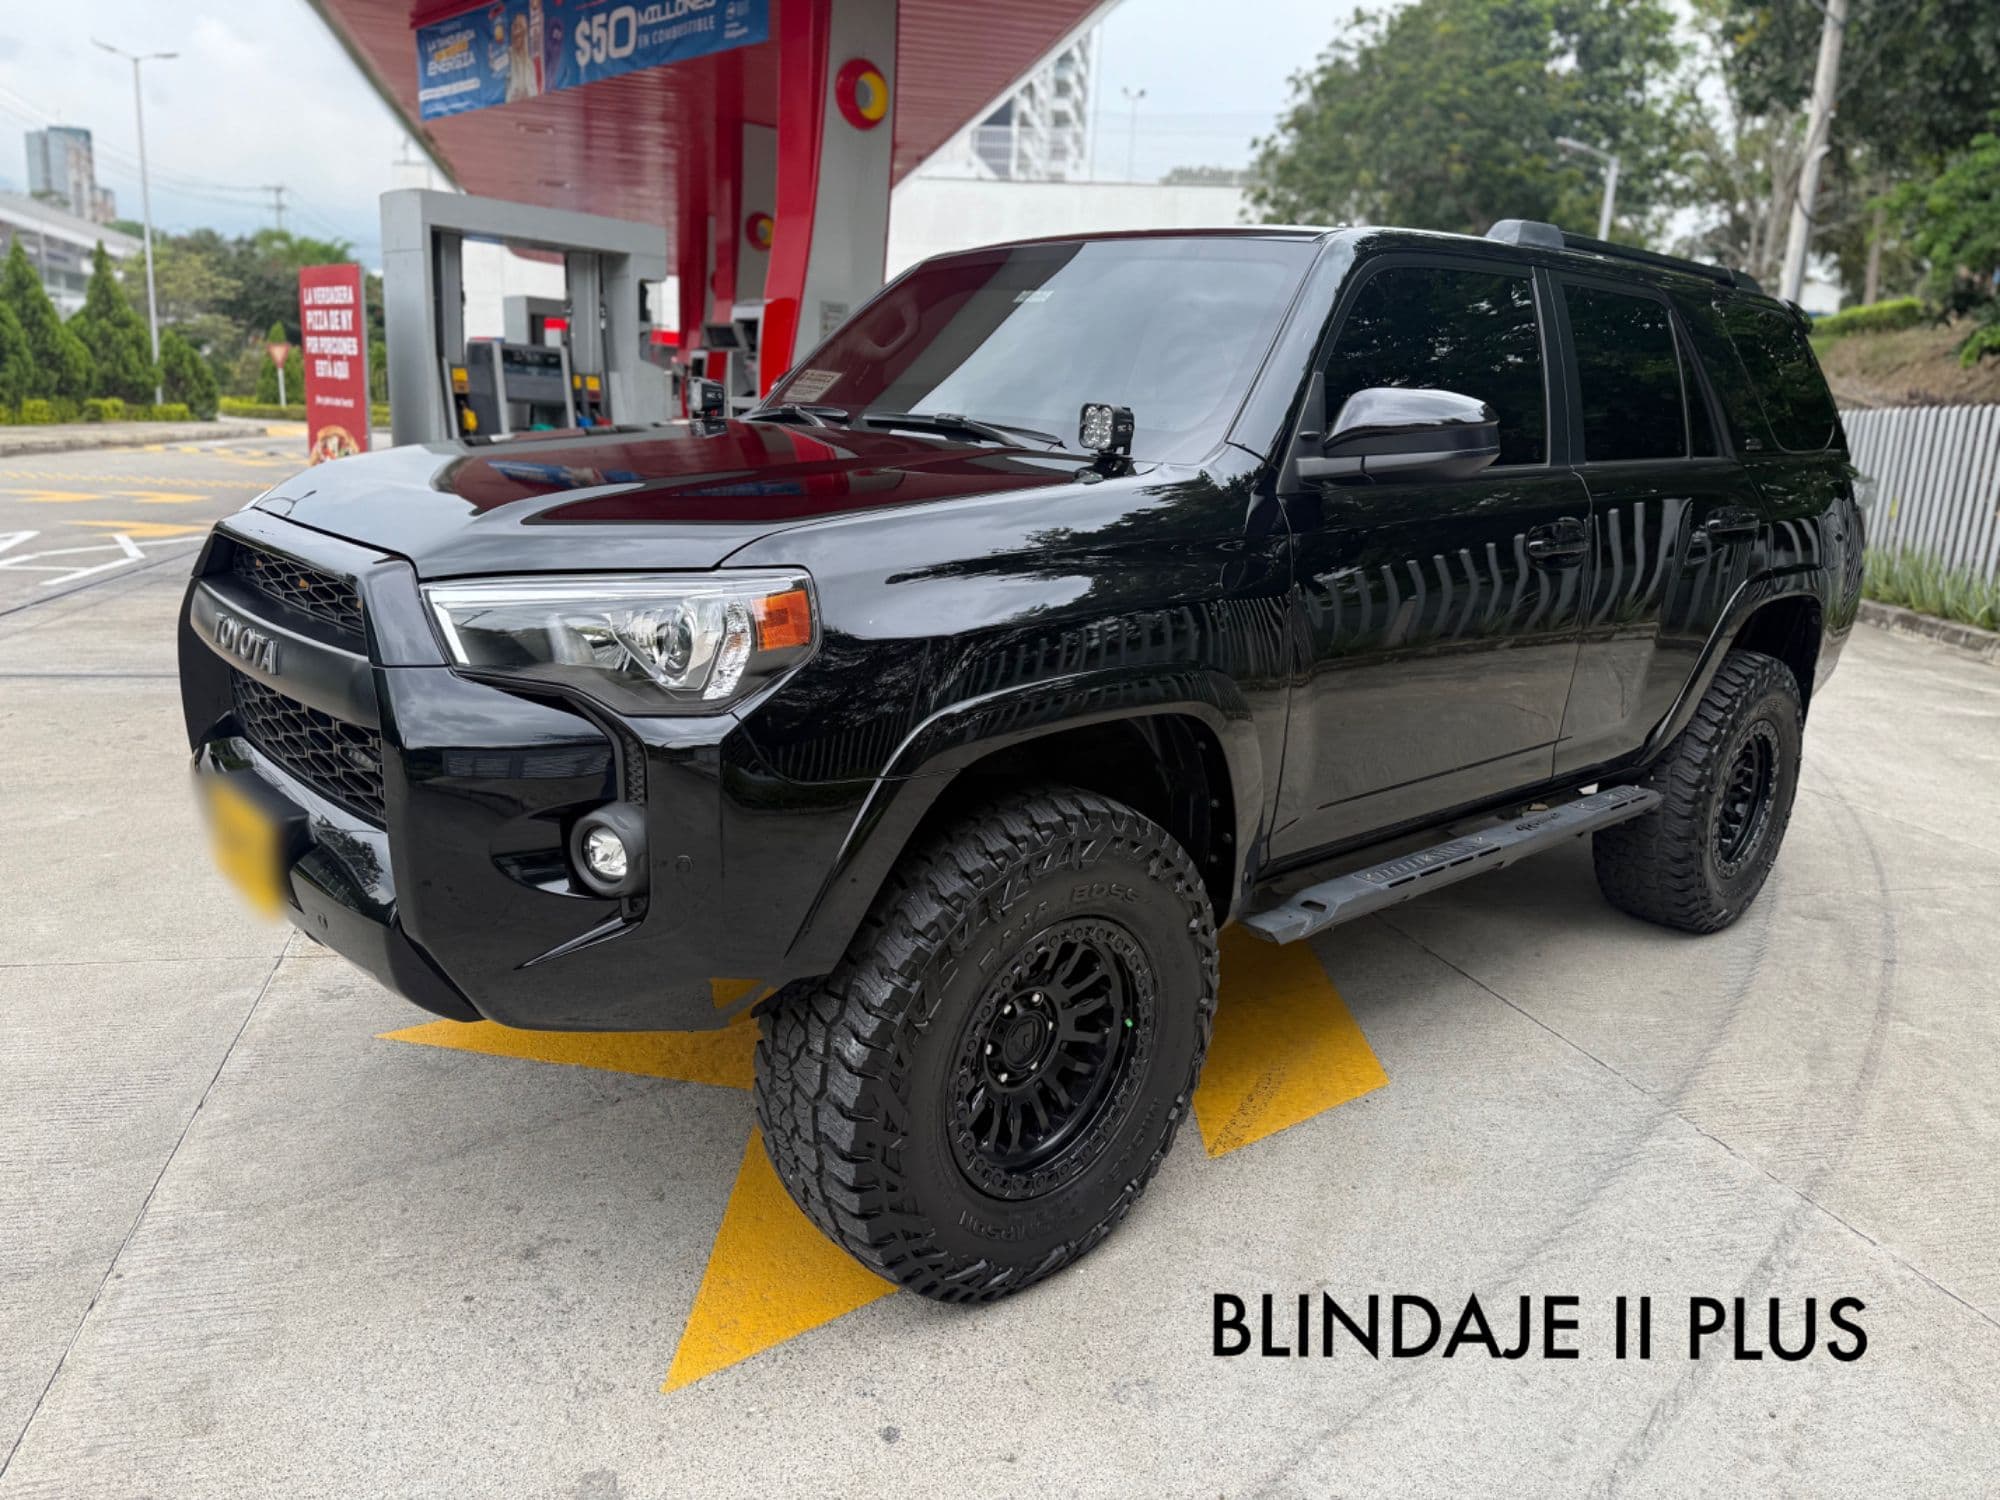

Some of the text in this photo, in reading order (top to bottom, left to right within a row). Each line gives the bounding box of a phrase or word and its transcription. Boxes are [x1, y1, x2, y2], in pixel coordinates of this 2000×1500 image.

[574, 6, 637, 66] $50
[652, 15, 716, 45] COMBUSTIBLE
[303, 285, 354, 305] LA VERDADERA
[306, 309, 353, 331] PIZZA DE NY
[306, 336, 358, 356] POR PORCIONES
[213, 612, 280, 675] TOYOTA
